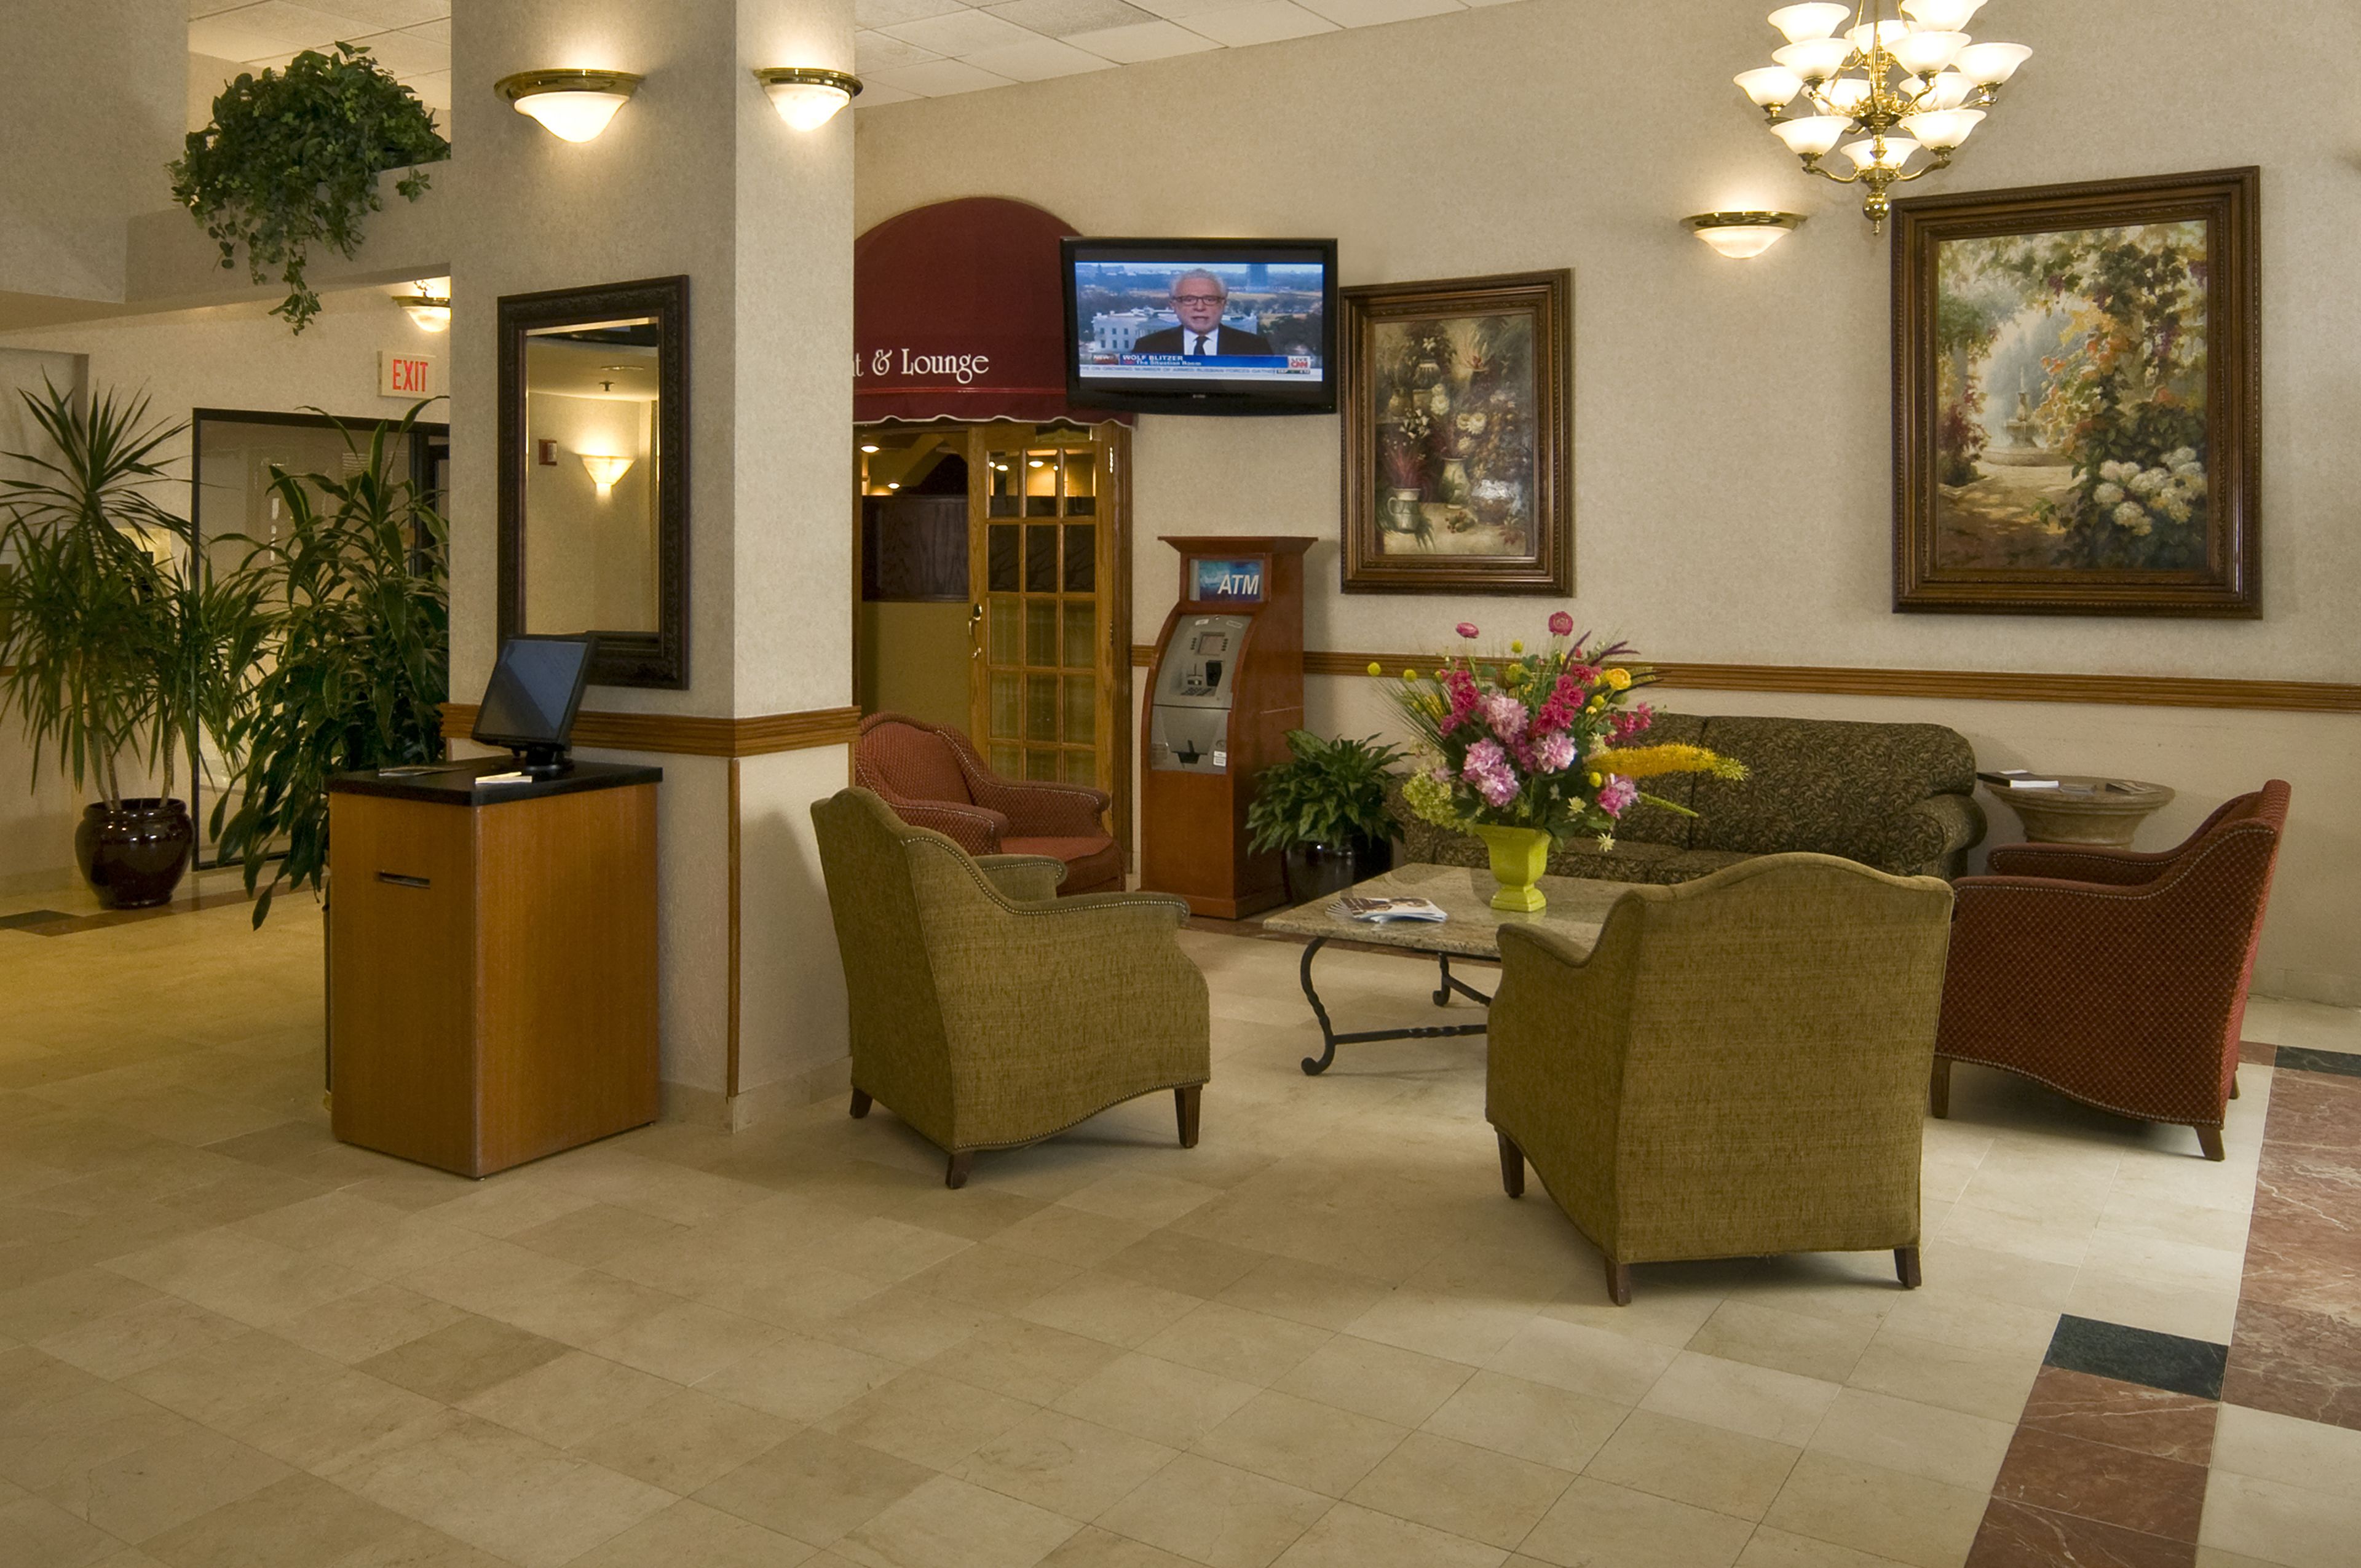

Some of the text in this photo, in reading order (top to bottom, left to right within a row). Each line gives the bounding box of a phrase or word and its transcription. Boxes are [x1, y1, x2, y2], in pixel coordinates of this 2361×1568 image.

[392, 358, 429, 392] EXIT
[872, 349, 892, 376] &
[901, 348, 989, 384] Lounge
[1217, 574, 1260, 595] ATM
